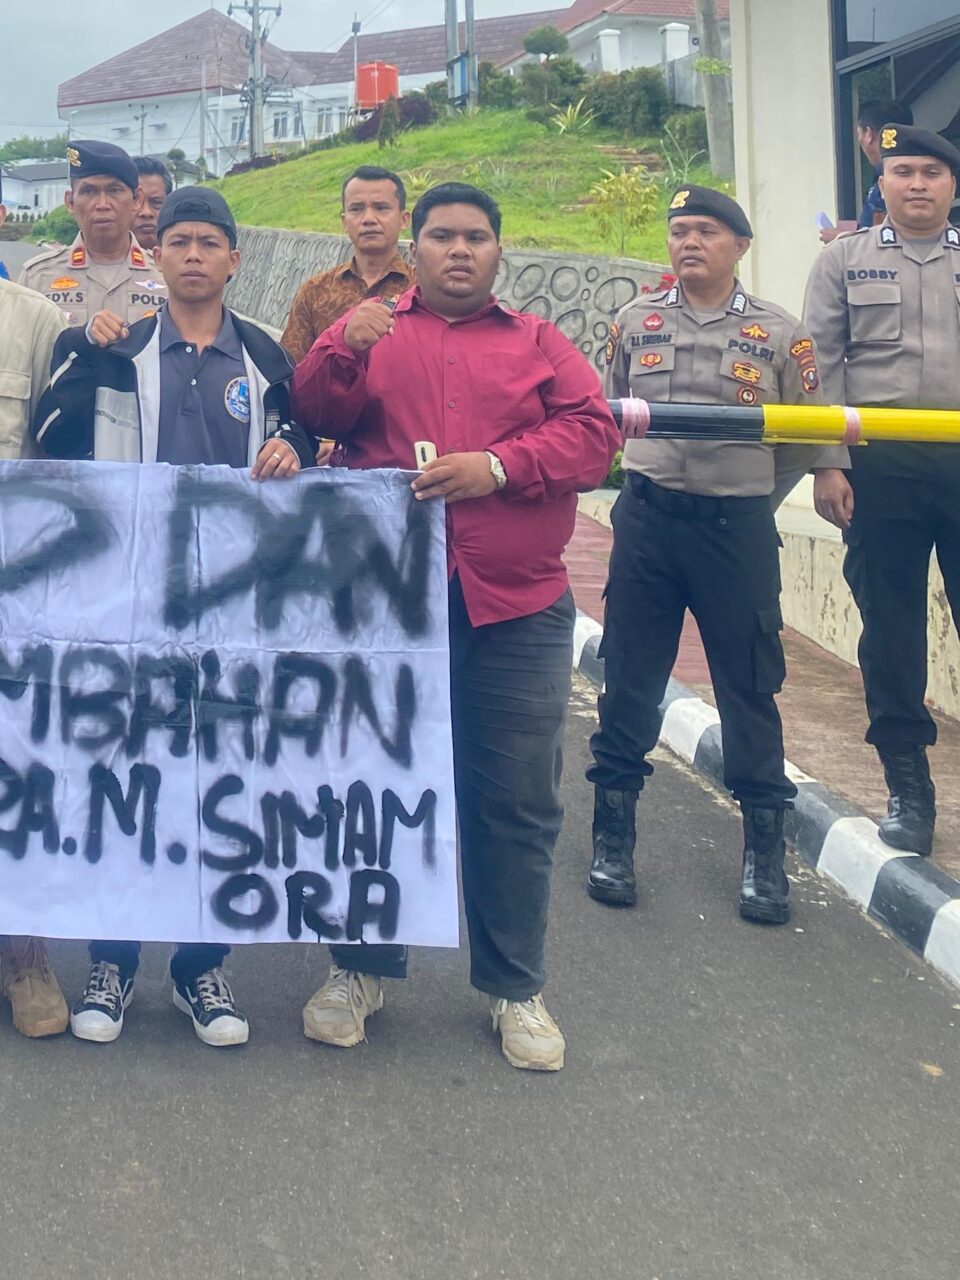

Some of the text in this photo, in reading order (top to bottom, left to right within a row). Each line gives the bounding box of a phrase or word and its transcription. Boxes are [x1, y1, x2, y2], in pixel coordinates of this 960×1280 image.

[846, 269, 898, 281] BOBBY
[728, 339, 775, 362] POLRI
[163, 479, 435, 640] DAN
[210, 868, 402, 942] ORA
